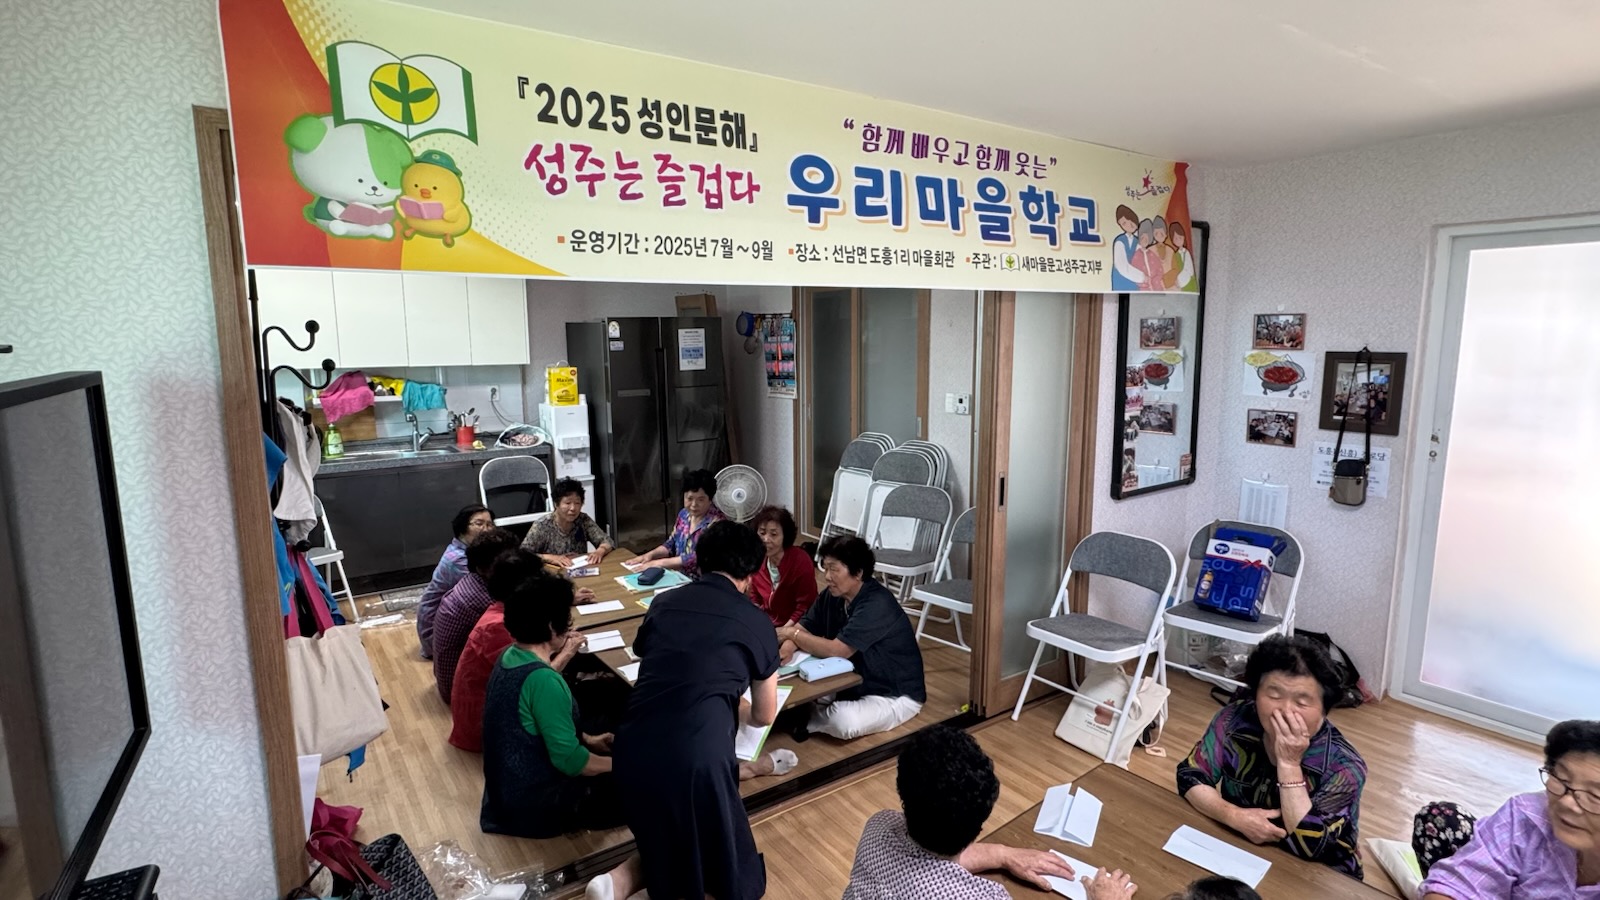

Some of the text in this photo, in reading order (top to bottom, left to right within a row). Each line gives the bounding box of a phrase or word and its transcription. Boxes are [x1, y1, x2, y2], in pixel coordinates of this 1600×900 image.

[911, 132, 971, 166] 배우고
[976, 144, 1011, 172] 함께
[523, 143, 761, 209] 성주는 즐겁다
[654, 235, 707, 258] 2025년
[832, 245, 867, 264] 선남면
[870, 247, 910, 266] 도흥1리
[913, 249, 955, 268] 마을회관
